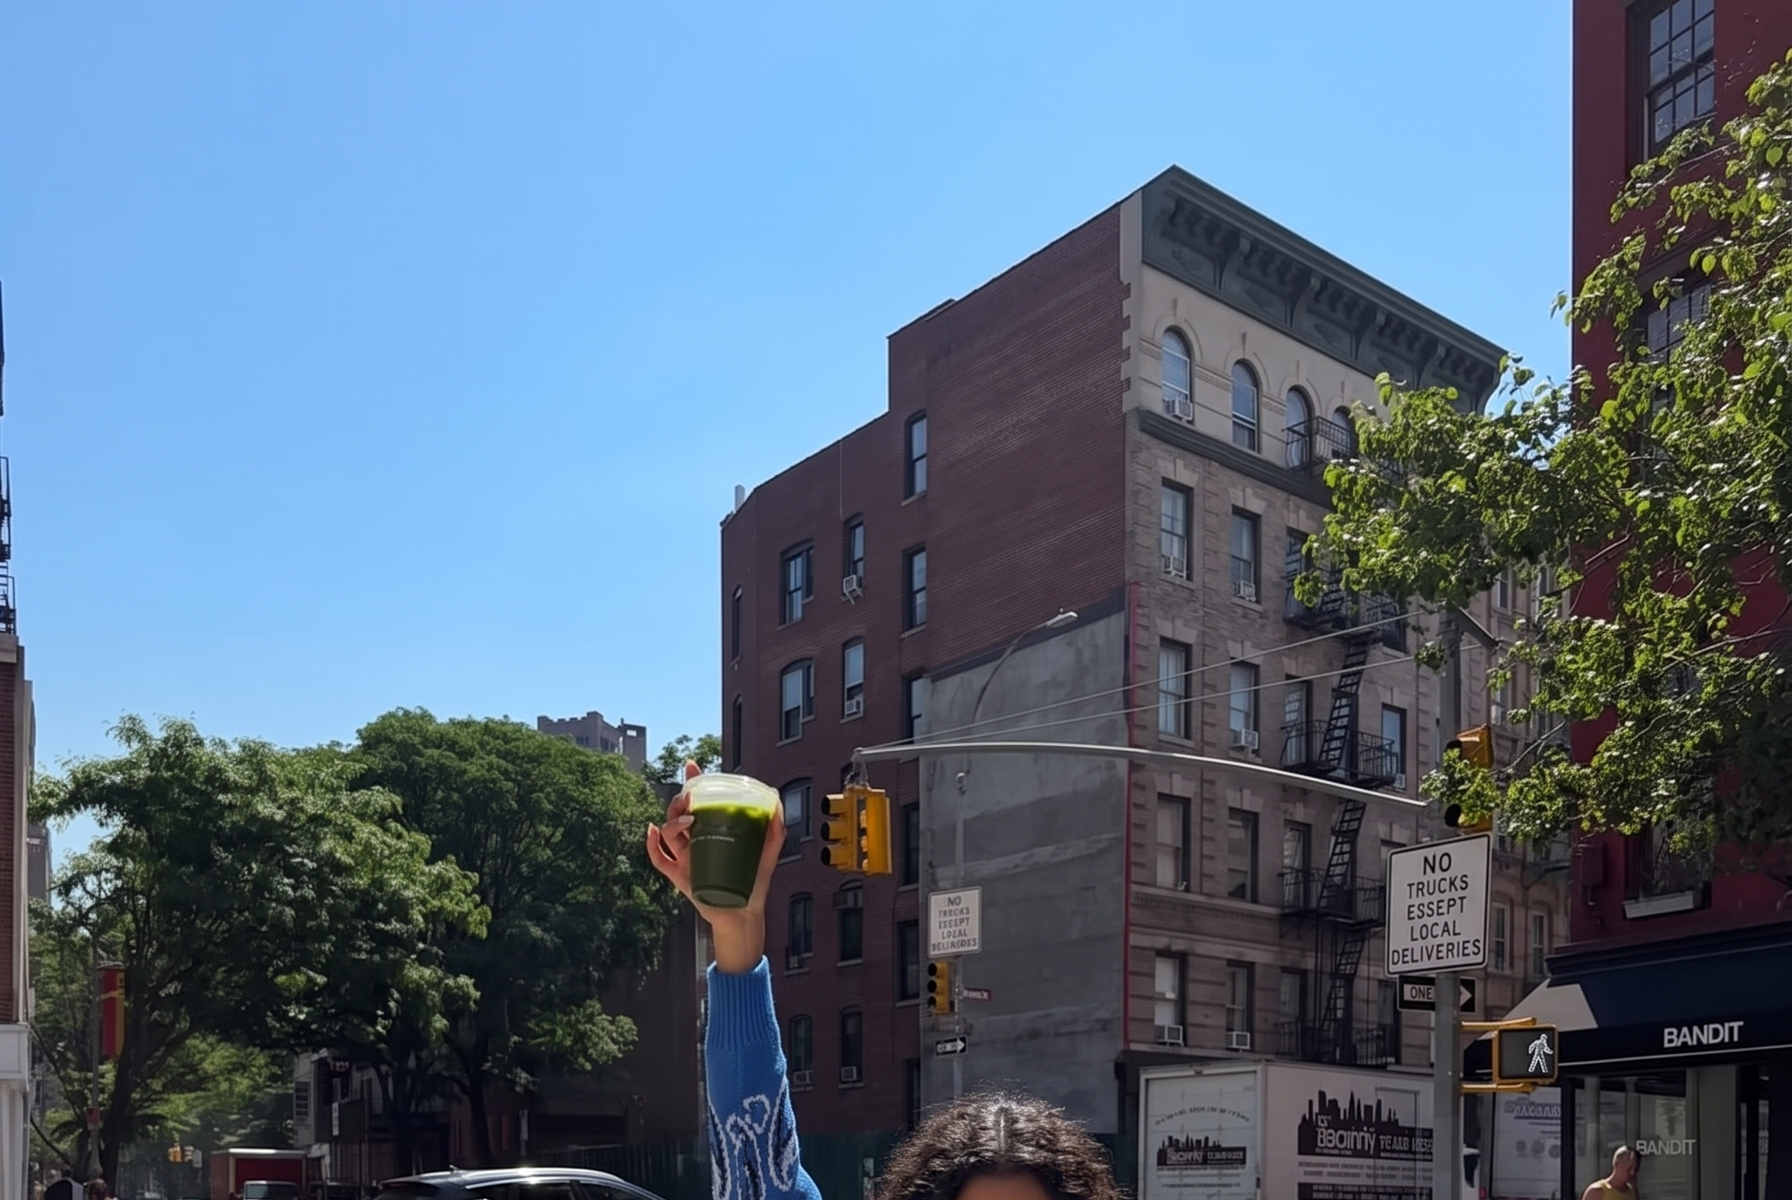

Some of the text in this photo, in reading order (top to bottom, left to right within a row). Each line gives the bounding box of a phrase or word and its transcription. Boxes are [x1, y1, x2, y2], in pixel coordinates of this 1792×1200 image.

[1423, 852, 1452, 876] NO
[1407, 874, 1469, 899] TRUCKS
[947, 895, 962, 907] NO
[1407, 896, 1467, 921] ESSEPT
[1410, 920, 1461, 942] LOCAL
[1391, 938, 1481, 966] DELIVERIES
[1410, 986, 1433, 1000] ONE
[1663, 1020, 1744, 1048] BANDIT
[1636, 1139, 1697, 1155] BANDIT
